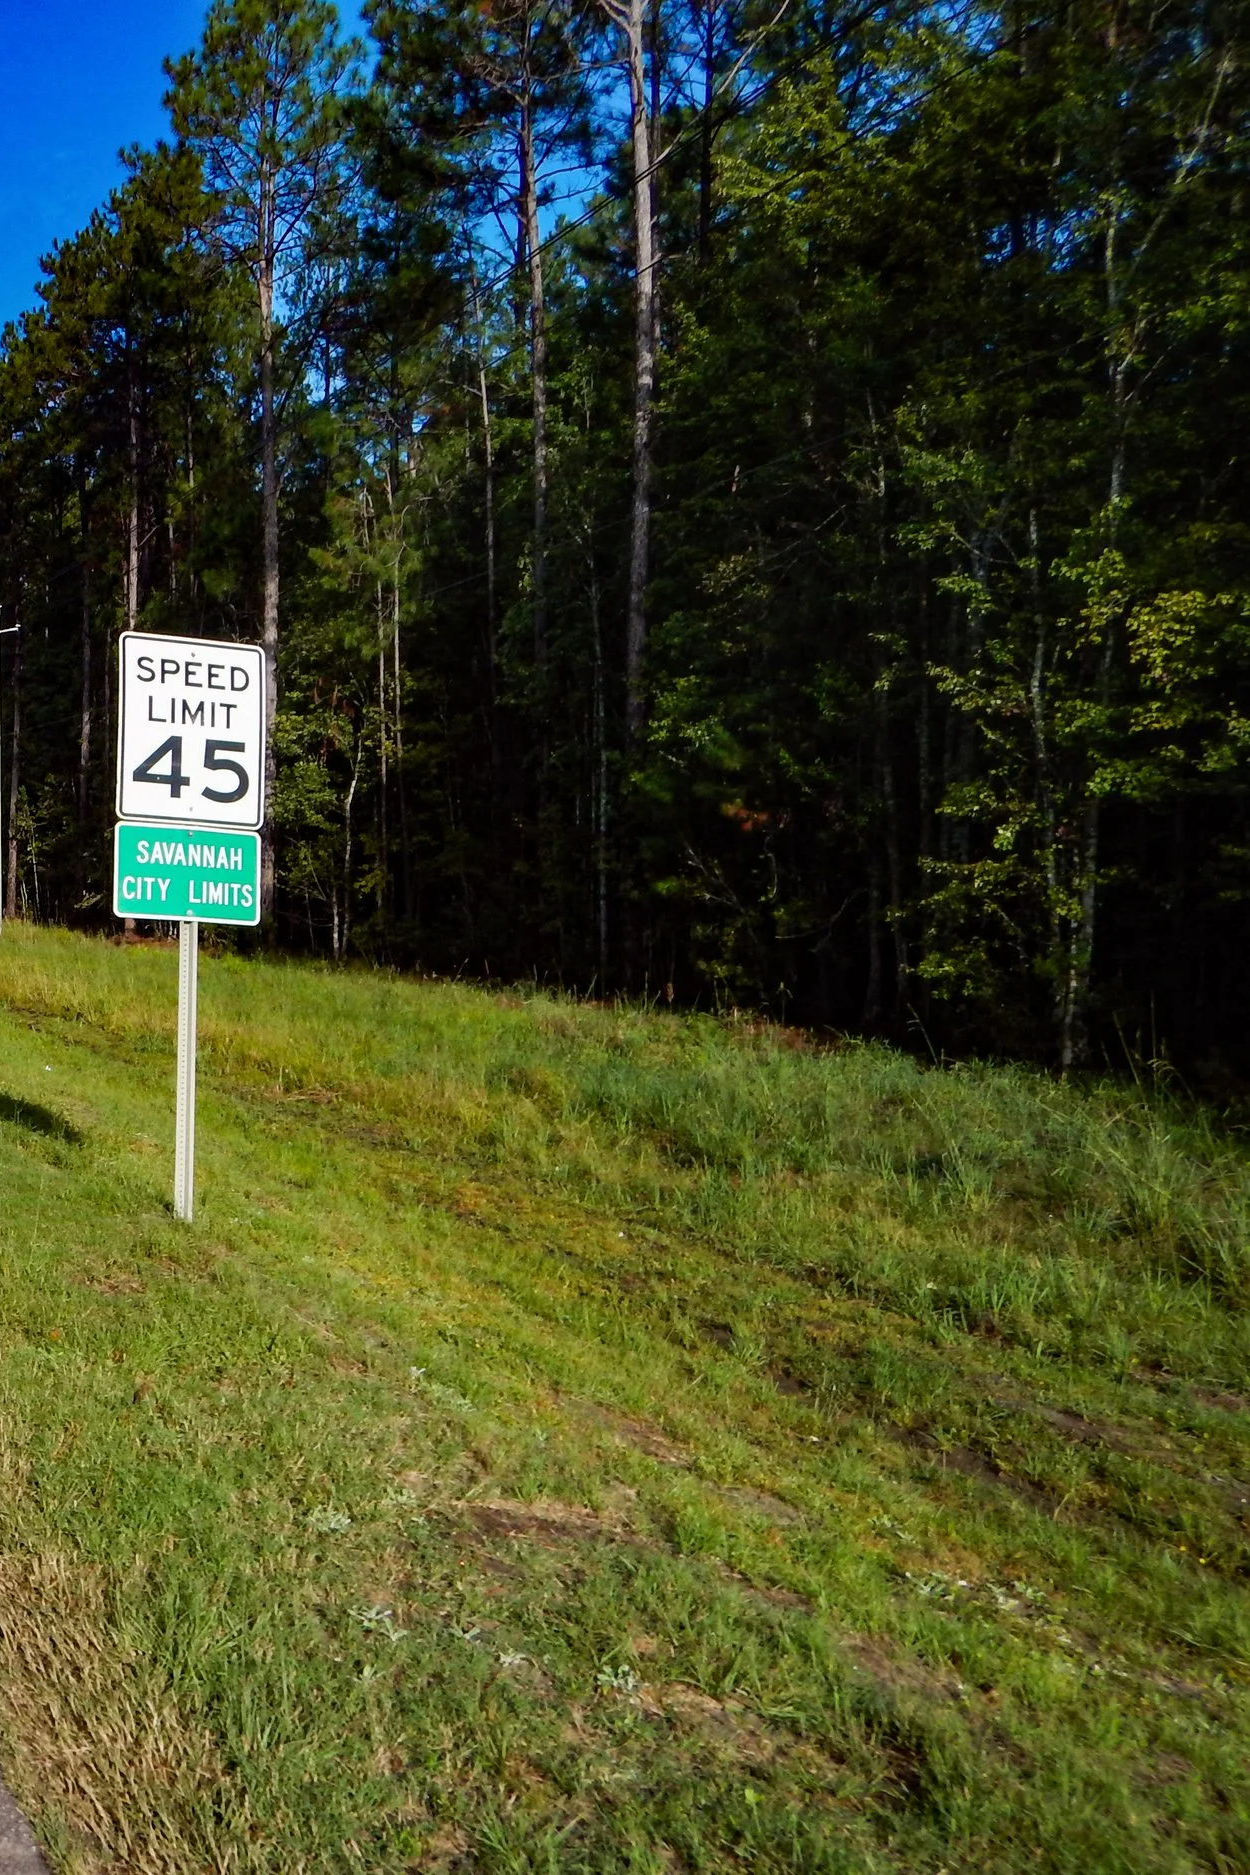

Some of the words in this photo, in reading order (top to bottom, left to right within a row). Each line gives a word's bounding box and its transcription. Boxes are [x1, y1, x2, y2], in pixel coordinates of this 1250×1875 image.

[136, 656, 250, 692] SPEED
[148, 695, 238, 729] LIMIT
[132, 735, 250, 803] 45
[136, 840, 243, 871] SAVANNAH
[122, 875, 171, 901] CITY
[189, 879, 253, 908] LIMITS
